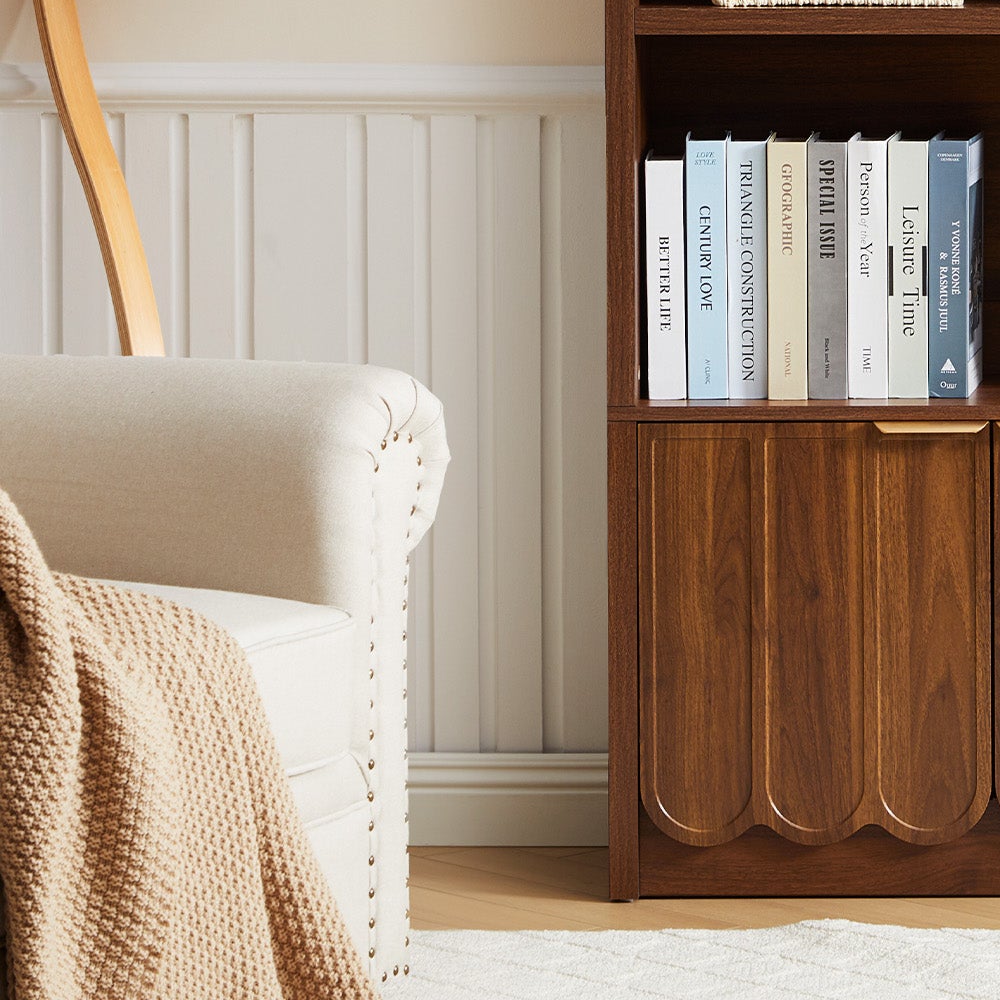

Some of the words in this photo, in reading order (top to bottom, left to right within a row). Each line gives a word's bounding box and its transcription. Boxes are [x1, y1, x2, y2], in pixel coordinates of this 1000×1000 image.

[739, 160, 753, 245] TRIANGLE
[819, 159, 835, 215] SPECIAL
[859, 162, 873, 216] Person
[698, 205, 711, 275] CENTURY
[819, 221, 836, 259] ISSUE
[858, 218, 868, 228] of
[860, 230, 870, 244] the
[902, 206, 919, 276] Leisure
[658, 236, 671, 294] BETTER
[860, 242, 873, 278] Year
[939, 251, 948, 260] &
[700, 278, 713, 311] LOVE
[939, 266, 948, 307] RASMUS
[951, 267, 961, 295] KONÉ
[659, 297, 671, 332] LIFE
[740, 248, 755, 382] CONSTRUCTION
[903, 287, 920, 337] Time
[938, 308, 948, 333] JUUL
[784, 341, 792, 378] NATIONAL
[862, 346, 871, 373] TIME
